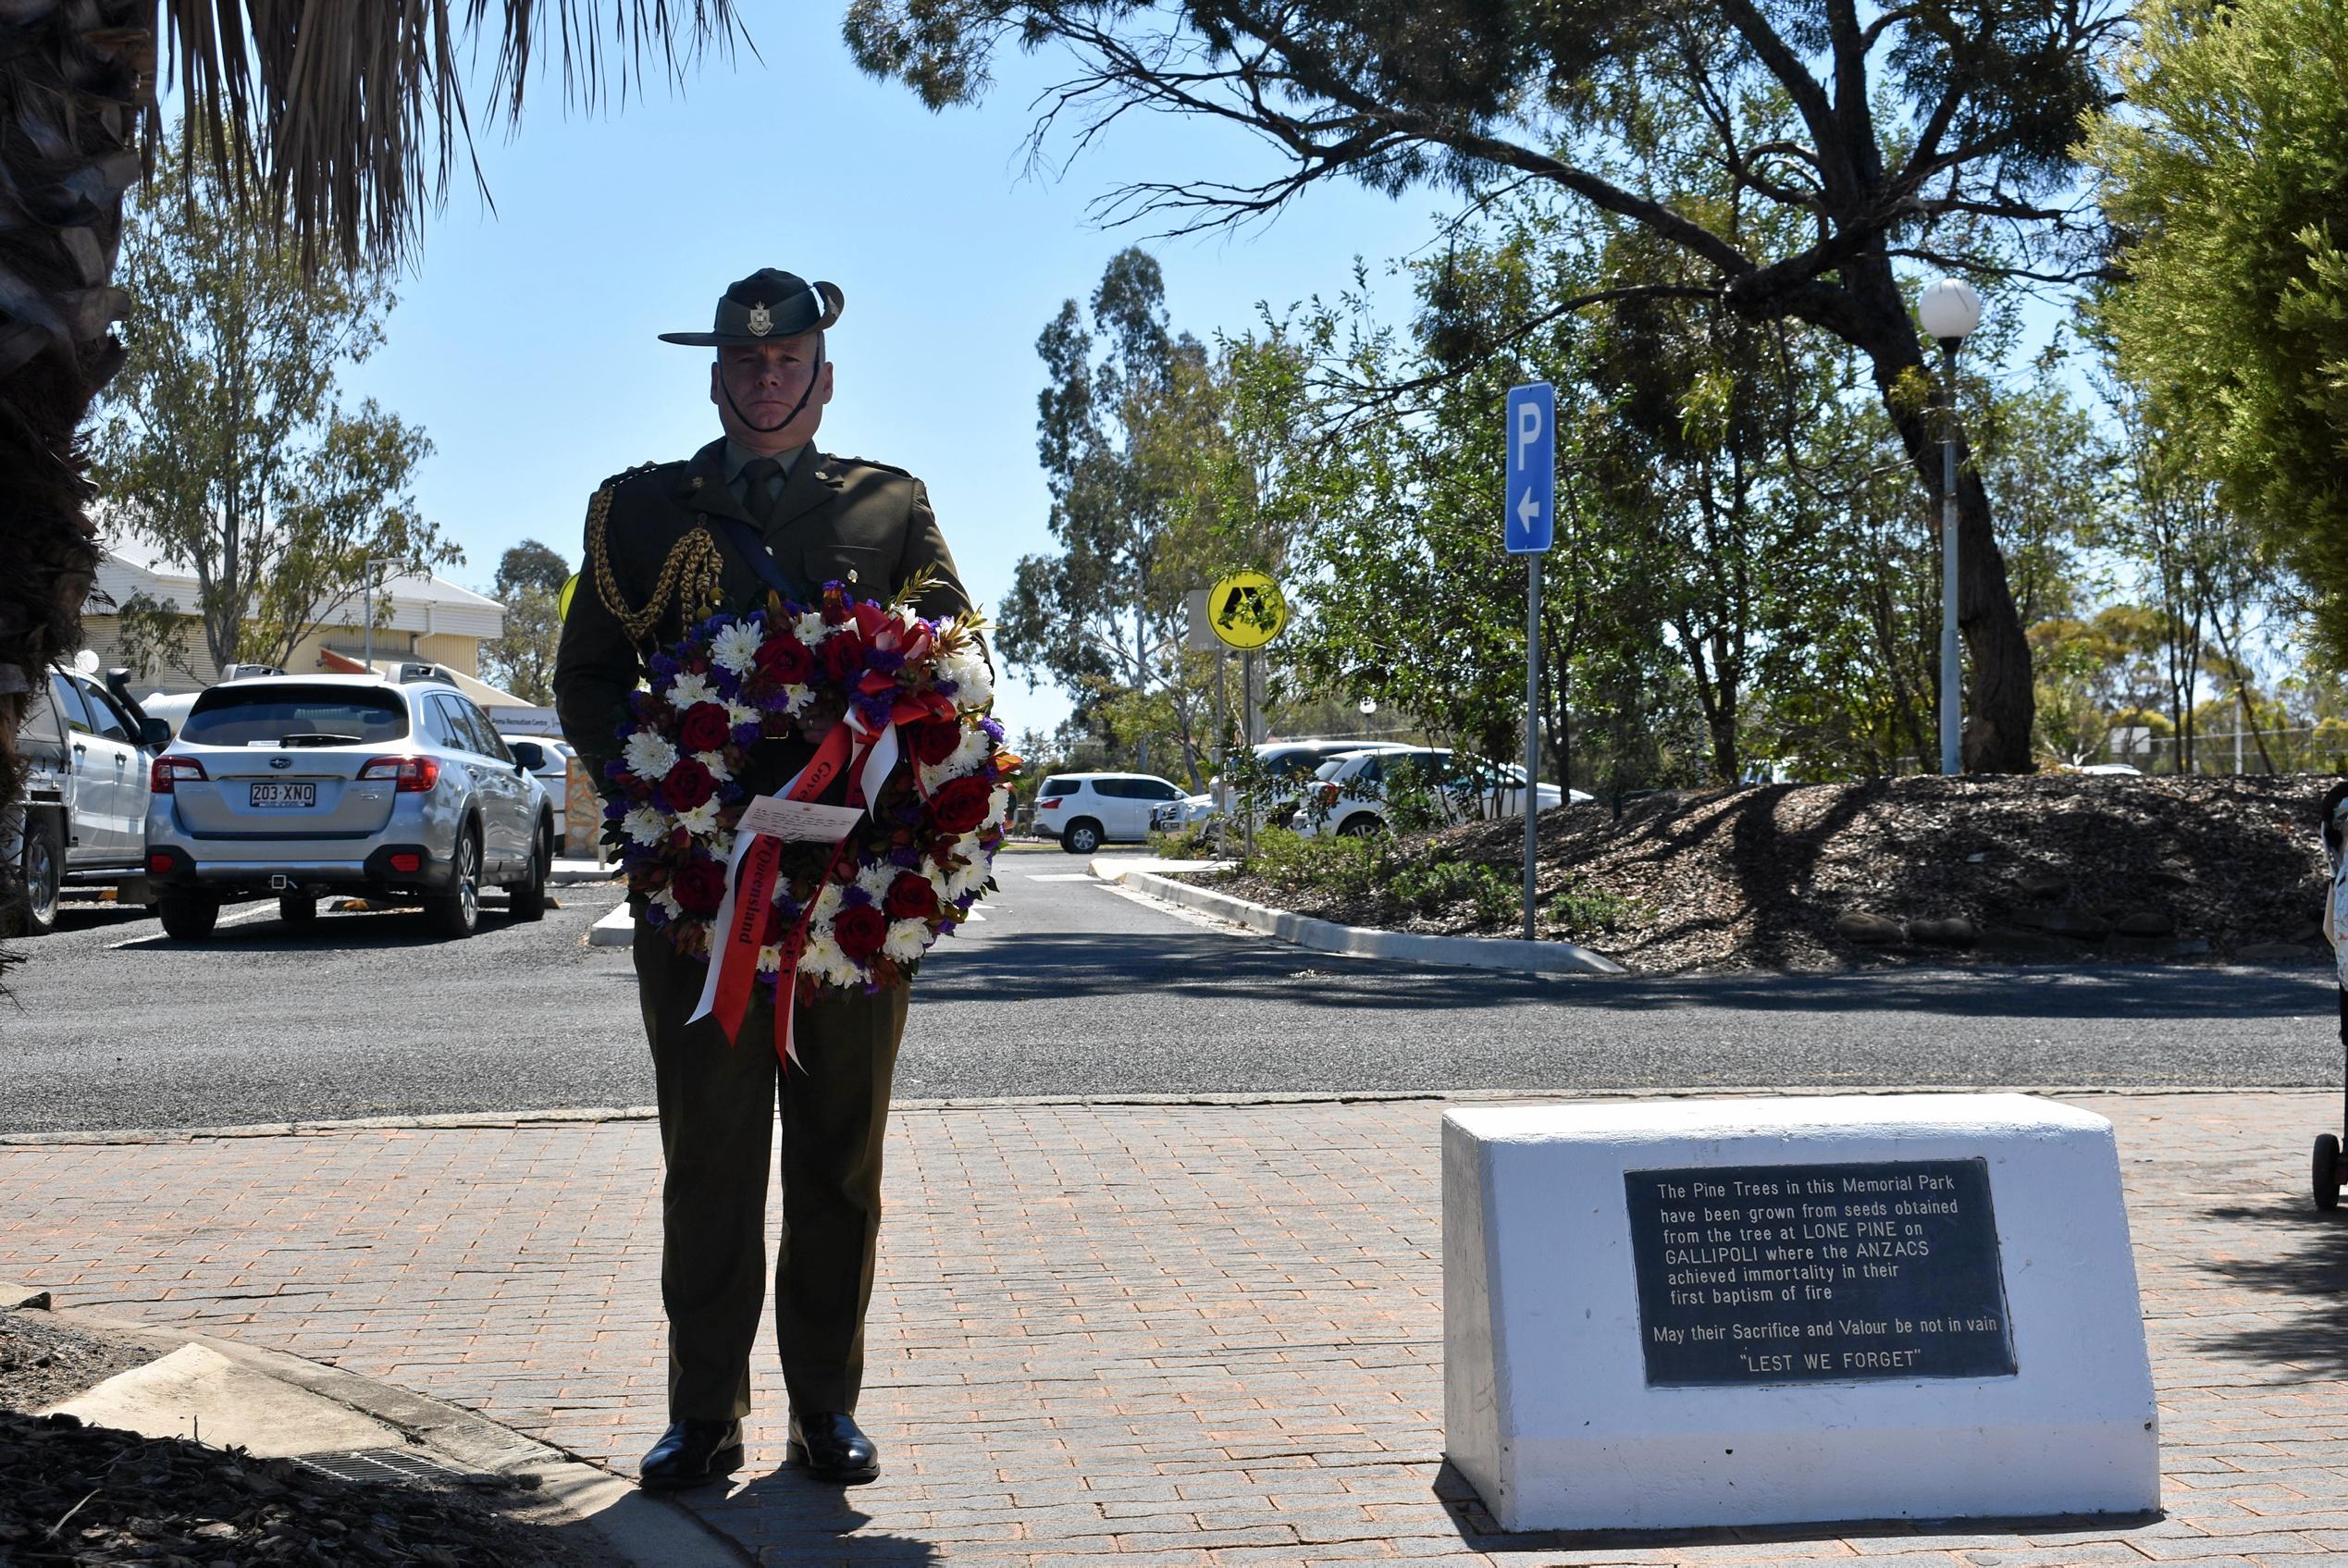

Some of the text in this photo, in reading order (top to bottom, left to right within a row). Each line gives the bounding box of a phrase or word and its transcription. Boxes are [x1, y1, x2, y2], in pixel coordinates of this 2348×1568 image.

[1518, 401, 1542, 471] P
[253, 785, 313, 800] 203 XNO
[739, 849, 772, 945] Queensland
[1658, 1174, 1955, 1199] The Pine Trees in this Memorial Park
[1660, 1198, 1959, 1224] have been grown from seeds obtained
[1663, 1220, 1923, 1244] from the tree at LONE PINE on
[1665, 1240, 1930, 1266] GALLIPOLI where the ANZACS
[1668, 1262, 1899, 1285] achieved immortality in their
[1670, 1284, 1833, 1306] first baptism of fire
[1653, 1315, 1997, 1345] May their Sacrifice and Valour be not in vain
[1803, 1353, 1832, 1370] WE
